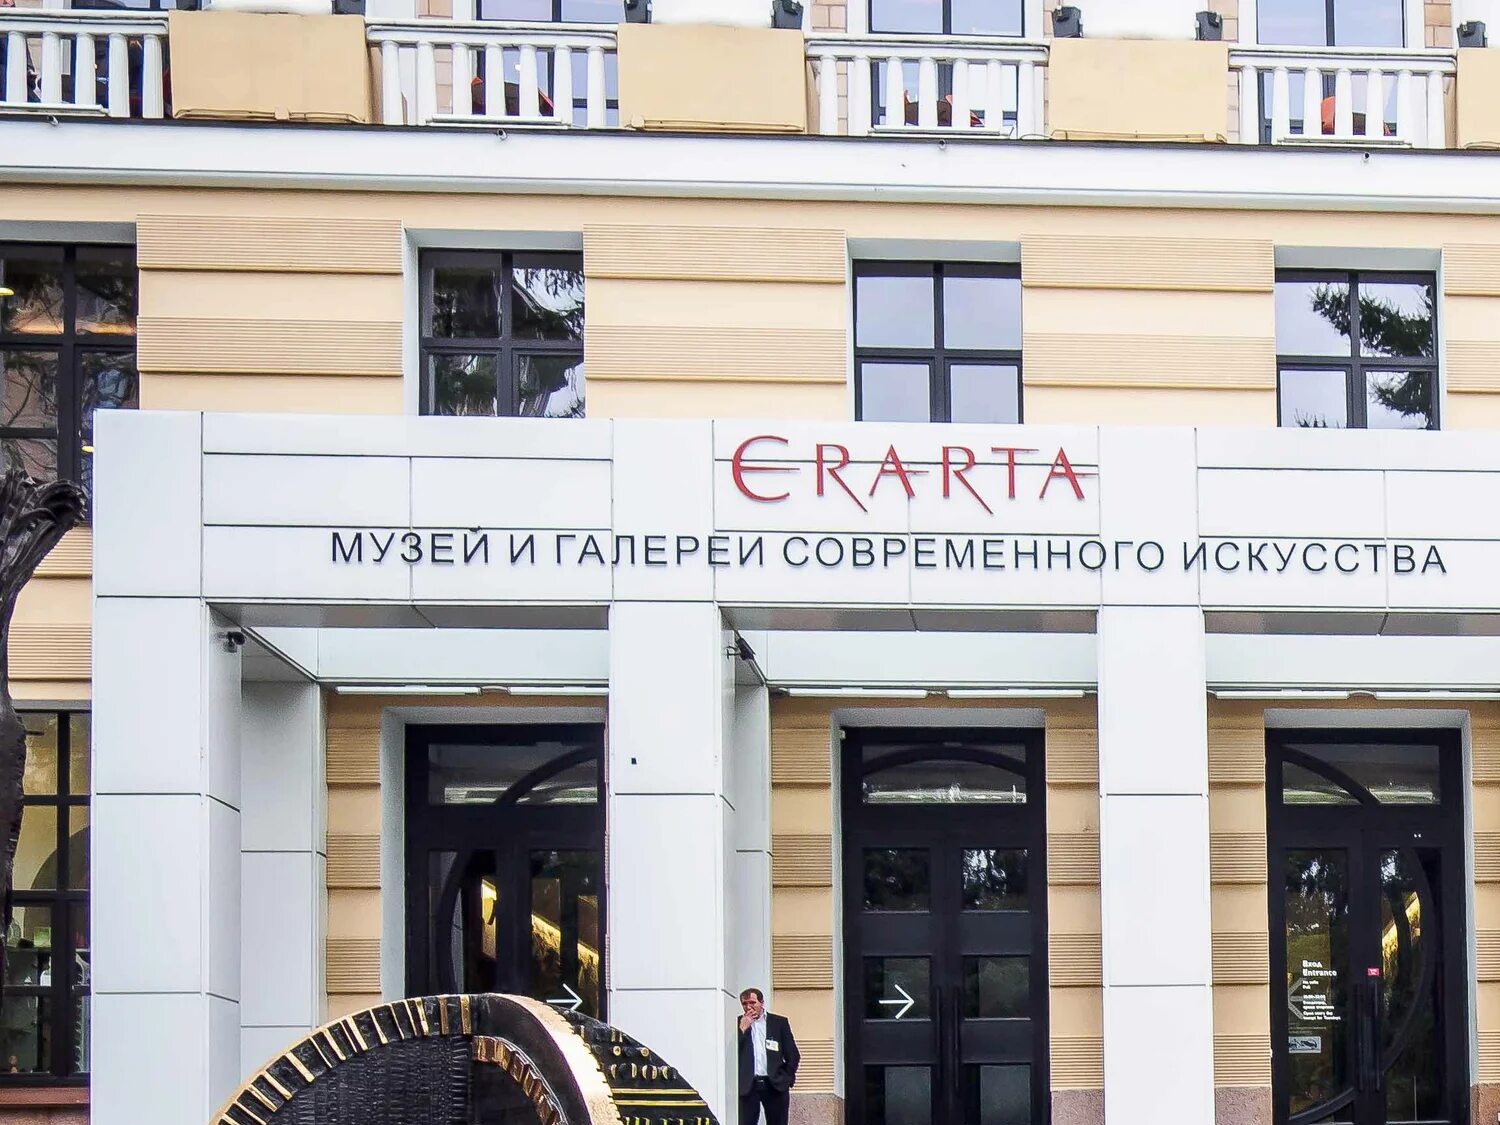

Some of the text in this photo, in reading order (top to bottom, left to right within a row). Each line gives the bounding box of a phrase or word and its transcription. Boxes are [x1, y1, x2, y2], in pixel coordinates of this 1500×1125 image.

[731, 435, 1098, 515] ERARTA
[330, 526, 1447, 574] МУЗЕЙ И ГАЛЕРЕИ СОВРЕМЕННОГО ИСКУССТВА
